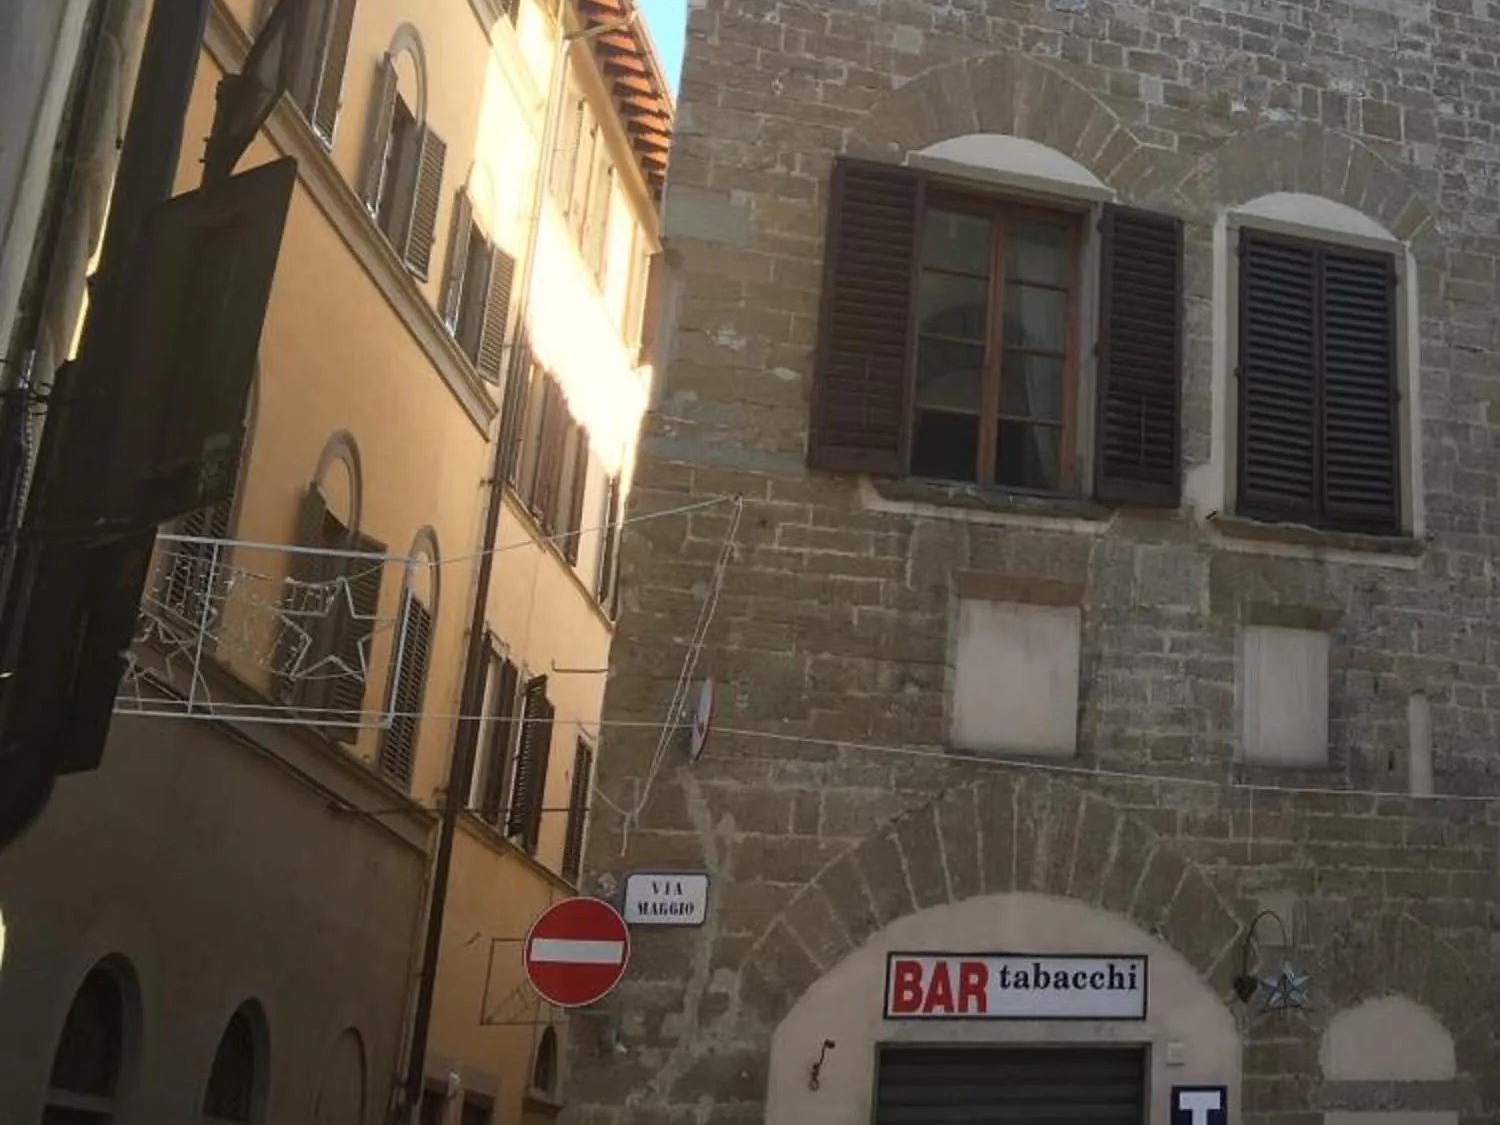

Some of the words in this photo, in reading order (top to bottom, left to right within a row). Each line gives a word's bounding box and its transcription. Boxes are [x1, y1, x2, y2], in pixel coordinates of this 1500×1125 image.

[651, 881, 683, 895] VIA
[638, 900, 694, 916] MAGGIO
[892, 960, 989, 1014] BAR
[999, 963, 1138, 991] tabacchi
[1179, 1090, 1221, 1125] T
